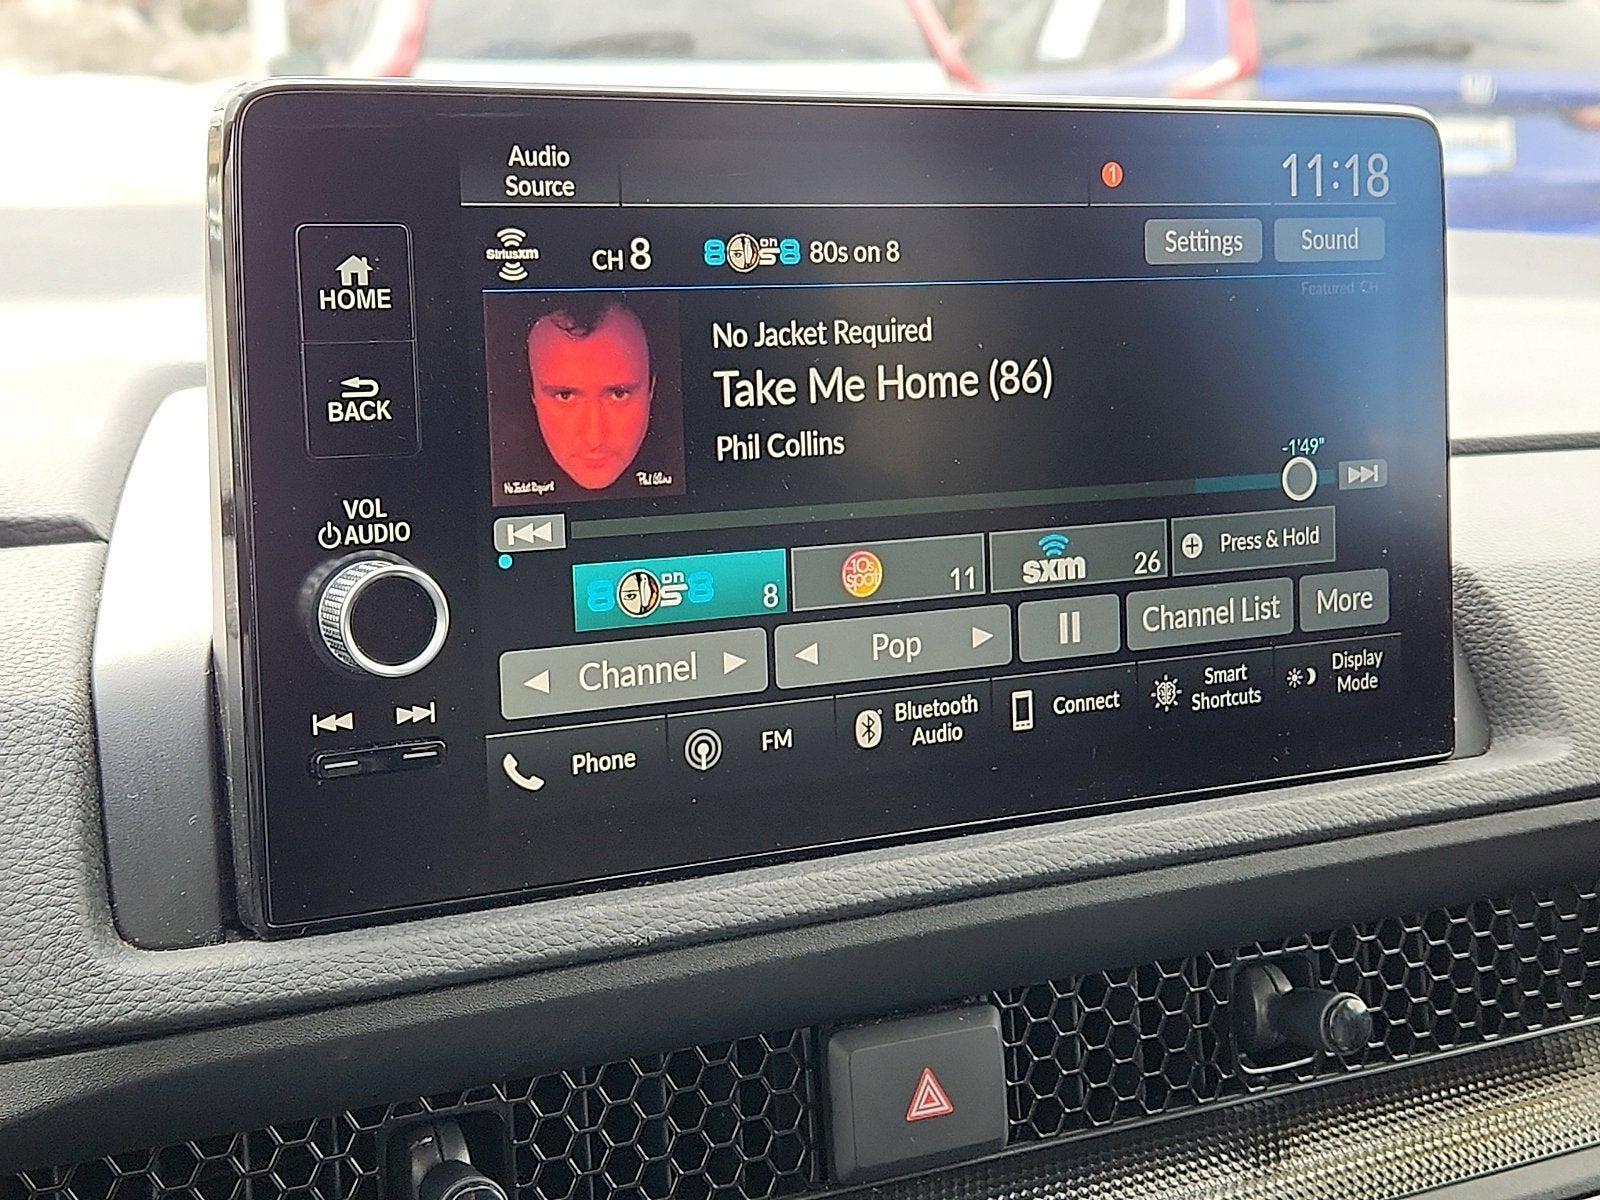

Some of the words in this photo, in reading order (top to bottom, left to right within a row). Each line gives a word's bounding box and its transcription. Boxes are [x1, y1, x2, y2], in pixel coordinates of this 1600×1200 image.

[508, 145, 571, 170] Audio
[504, 174, 576, 198] Source
[1282, 152, 1391, 198] 11:18
[1164, 229, 1244, 258] Settings
[1300, 227, 1360, 251] Sound
[591, 249, 624, 271] CH
[629, 236, 652, 271] 8
[809, 240, 849, 265] 80s
[853, 246, 881, 263] on
[886, 240, 901, 263] 8
[319, 288, 393, 311] HOME
[1300, 281, 1355, 296] Featured
[1359, 280, 1380, 294] CH
[711, 322, 749, 349] No
[754, 320, 828, 348] Jacket
[833, 316, 934, 348] Required
[713, 368, 797, 408] Take
[809, 366, 867, 403] Me
[877, 362, 980, 401] Home
[988, 356, 1053, 401] (86)
[327, 400, 393, 422] BACK
[716, 435, 761, 461] Phil
[766, 430, 846, 458] Collins
[342, 498, 388, 520] VOL
[344, 521, 411, 545] AUDIO
[1220, 531, 1262, 554] Press
[1265, 530, 1280, 549] &
[1282, 525, 1321, 548] Hold
[1133, 550, 1162, 576] 26
[949, 567, 977, 591] 11
[762, 583, 780, 609] 8
[1316, 587, 1374, 616] More
[1141, 600, 1236, 634] Channel
[1241, 595, 1281, 624] List
[871, 632, 923, 664] Pop
[1331, 648, 1384, 674] Display
[578, 651, 698, 693] Channel
[1203, 663, 1249, 687] Smart
[1336, 670, 1379, 694] Mode
[894, 692, 980, 724] Bluetooth
[1052, 689, 1121, 717] Connect
[1190, 685, 1263, 713] Shortcuts
[761, 728, 794, 753] FM
[911, 721, 964, 748] Audio
[571, 746, 638, 776] Phone
